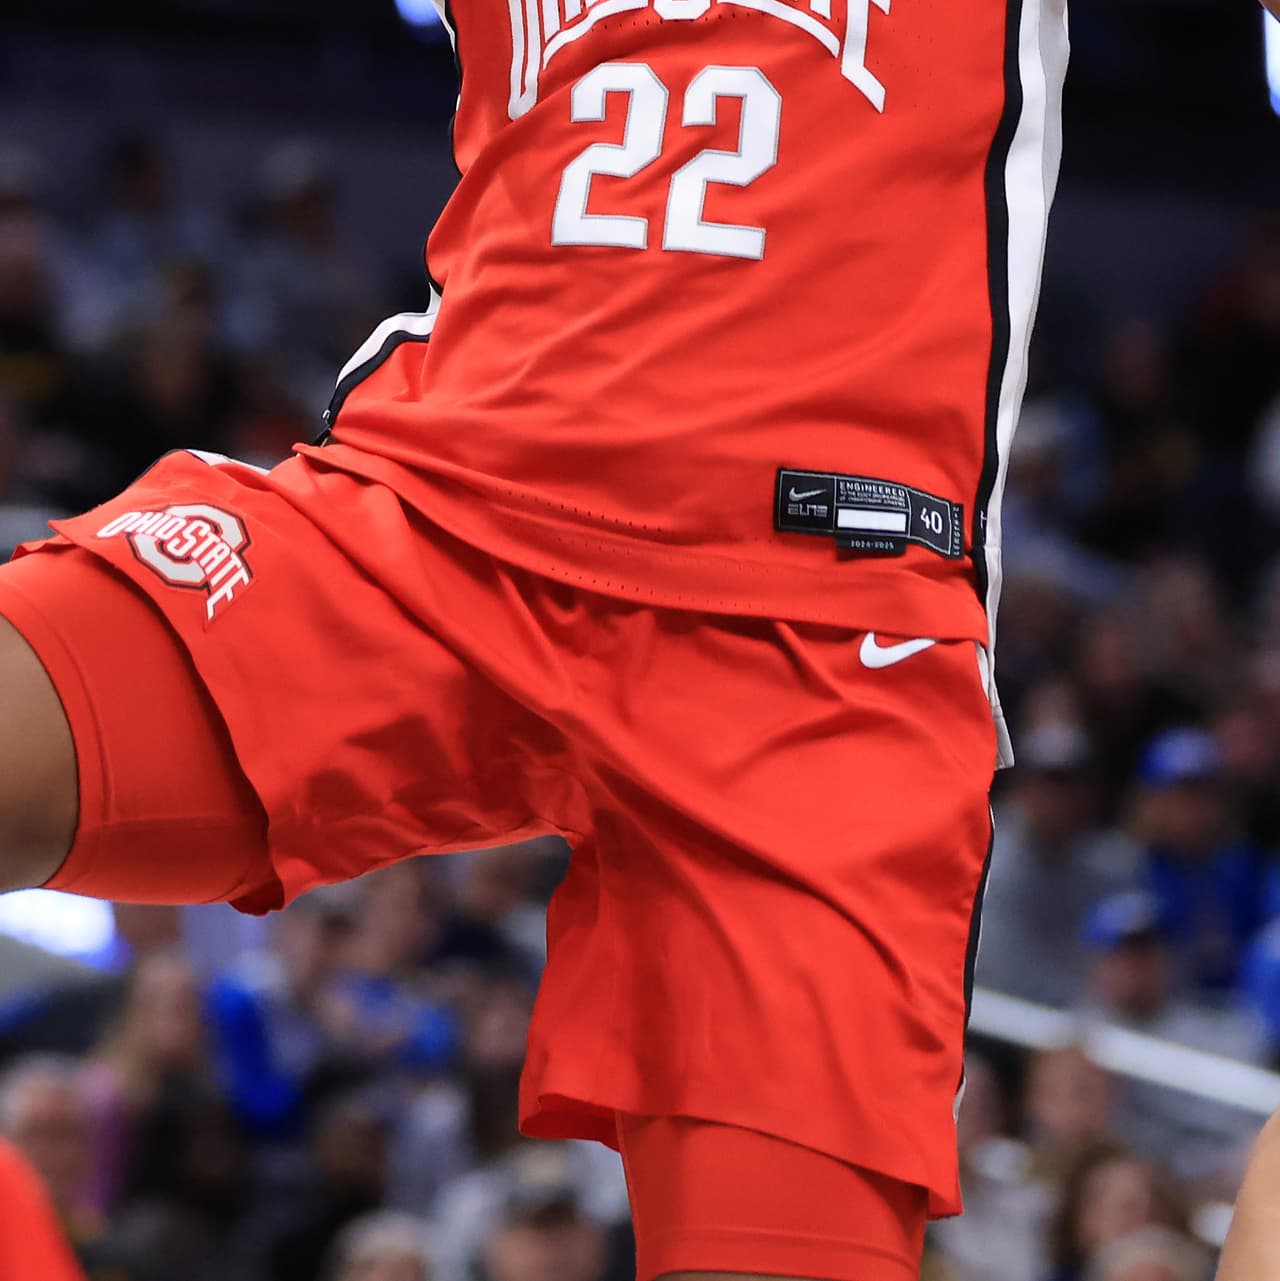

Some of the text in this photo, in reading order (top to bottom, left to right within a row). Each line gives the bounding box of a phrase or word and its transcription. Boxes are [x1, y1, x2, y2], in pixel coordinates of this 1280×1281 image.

[551, 63, 783, 261] 22
[839, 481, 905, 497] ENGINEERED
[920, 507, 944, 534] 40
[96, 511, 251, 621] OHIO STATE
